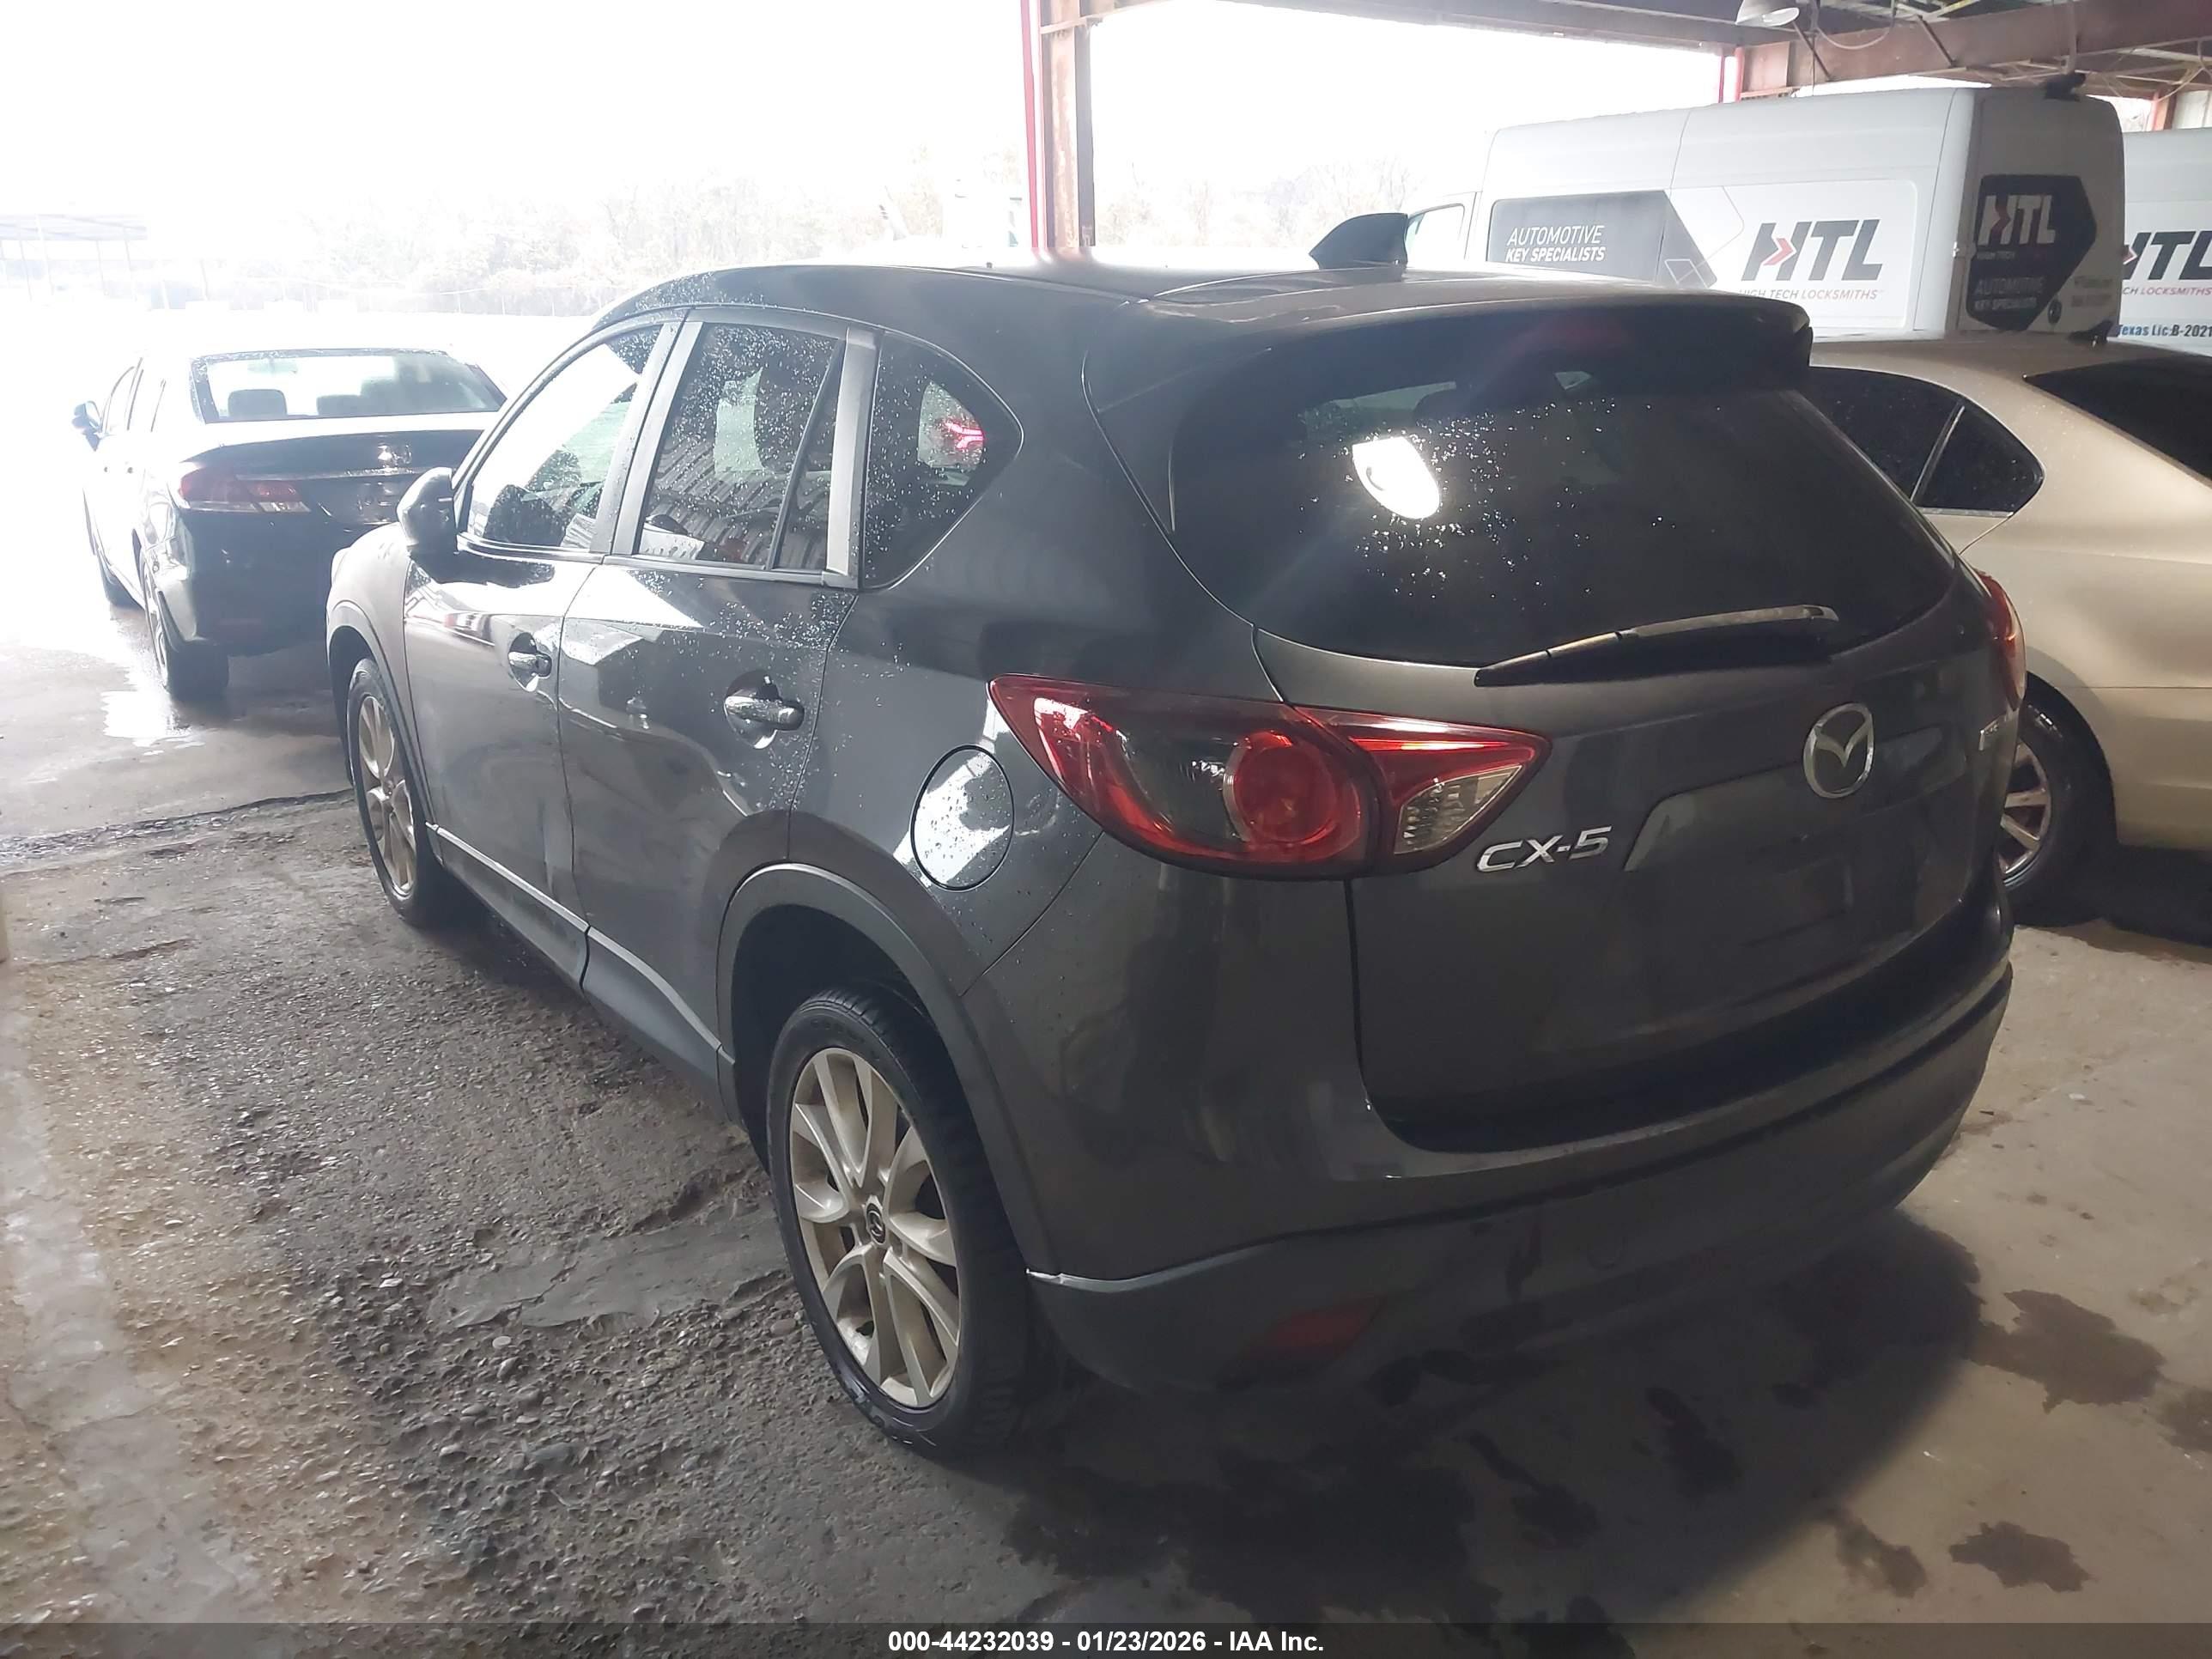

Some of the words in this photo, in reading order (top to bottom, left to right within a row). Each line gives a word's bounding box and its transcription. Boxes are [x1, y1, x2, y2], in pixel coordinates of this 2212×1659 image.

[1978, 195, 2057, 246] HTL
[1507, 225, 1605, 246] AUTOMOTIVE
[1505, 247, 1529, 262] KEY
[1530, 246, 1606, 262] SPECIALISTS
[1741, 219, 1883, 282] HTL
[1770, 289, 1801, 300] TECH
[1801, 289, 1878, 301] LOCKSMITHS
[2141, 287, 2212, 295] LOCKSMITHS
[1477, 826, 1613, 872] CX-5
